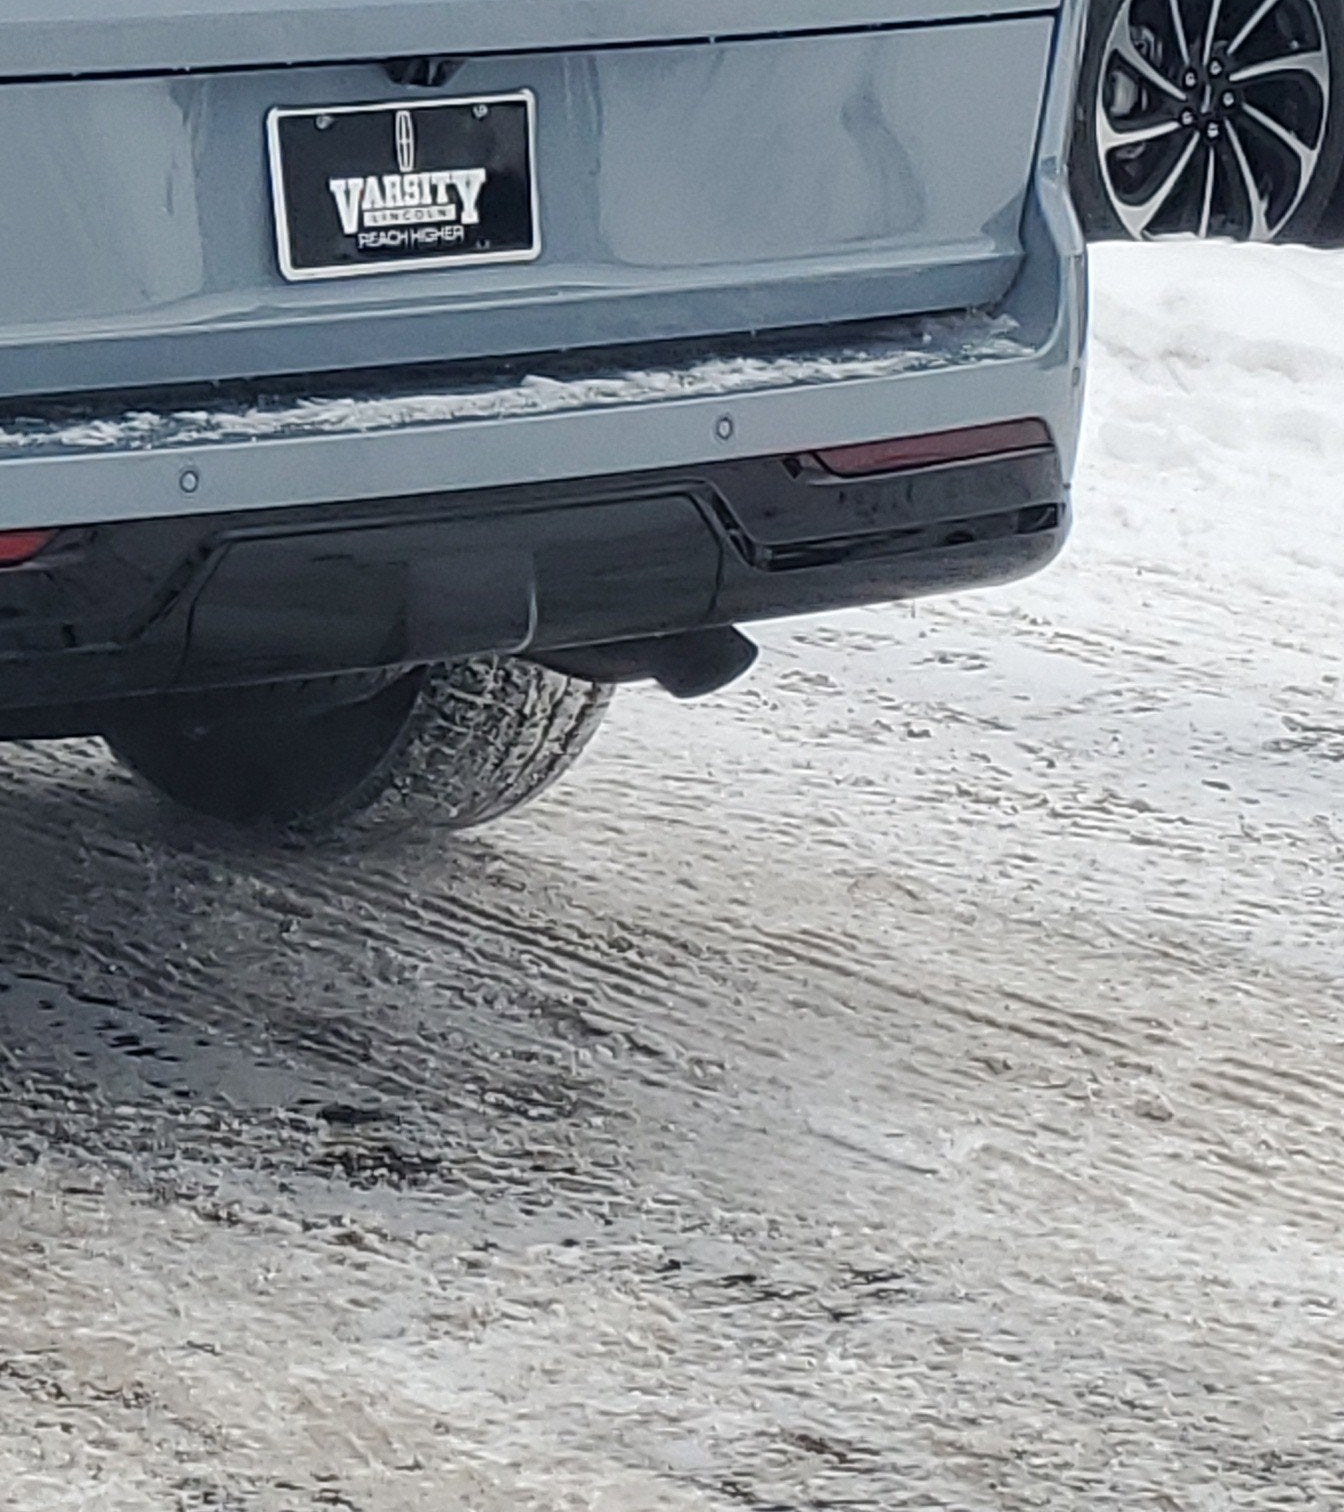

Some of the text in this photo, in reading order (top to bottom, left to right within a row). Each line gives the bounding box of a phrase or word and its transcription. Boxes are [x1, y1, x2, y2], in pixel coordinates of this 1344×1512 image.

[329, 168, 486, 235] VARSITY
[372, 209, 448, 224] LINCOLN
[358, 225, 464, 249] REACH HIGHER
